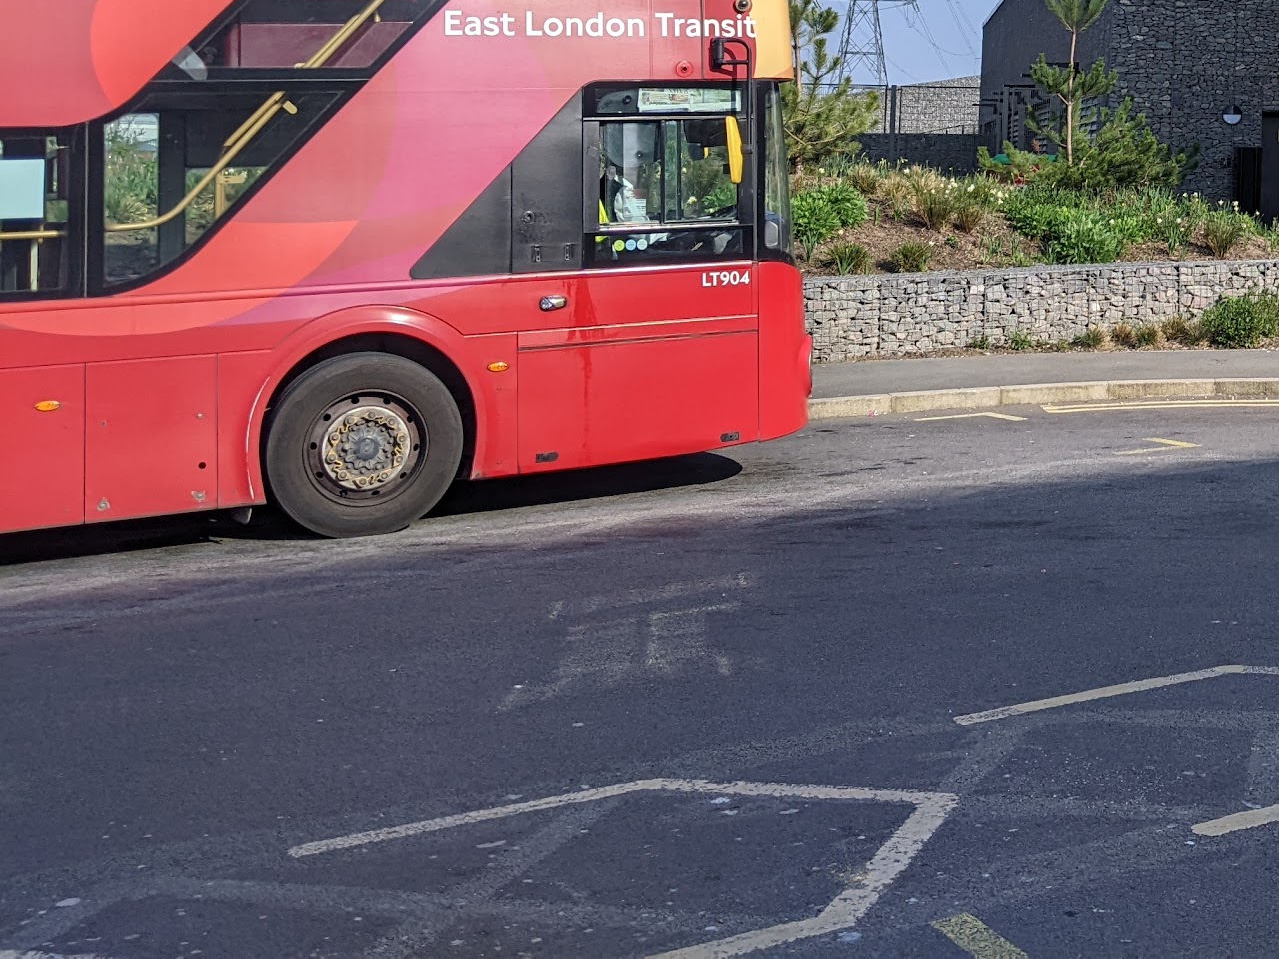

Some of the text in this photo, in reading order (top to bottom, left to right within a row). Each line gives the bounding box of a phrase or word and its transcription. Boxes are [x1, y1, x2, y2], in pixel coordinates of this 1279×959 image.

[443, 9, 757, 39] East London Transit
[702, 270, 750, 287] LT904
